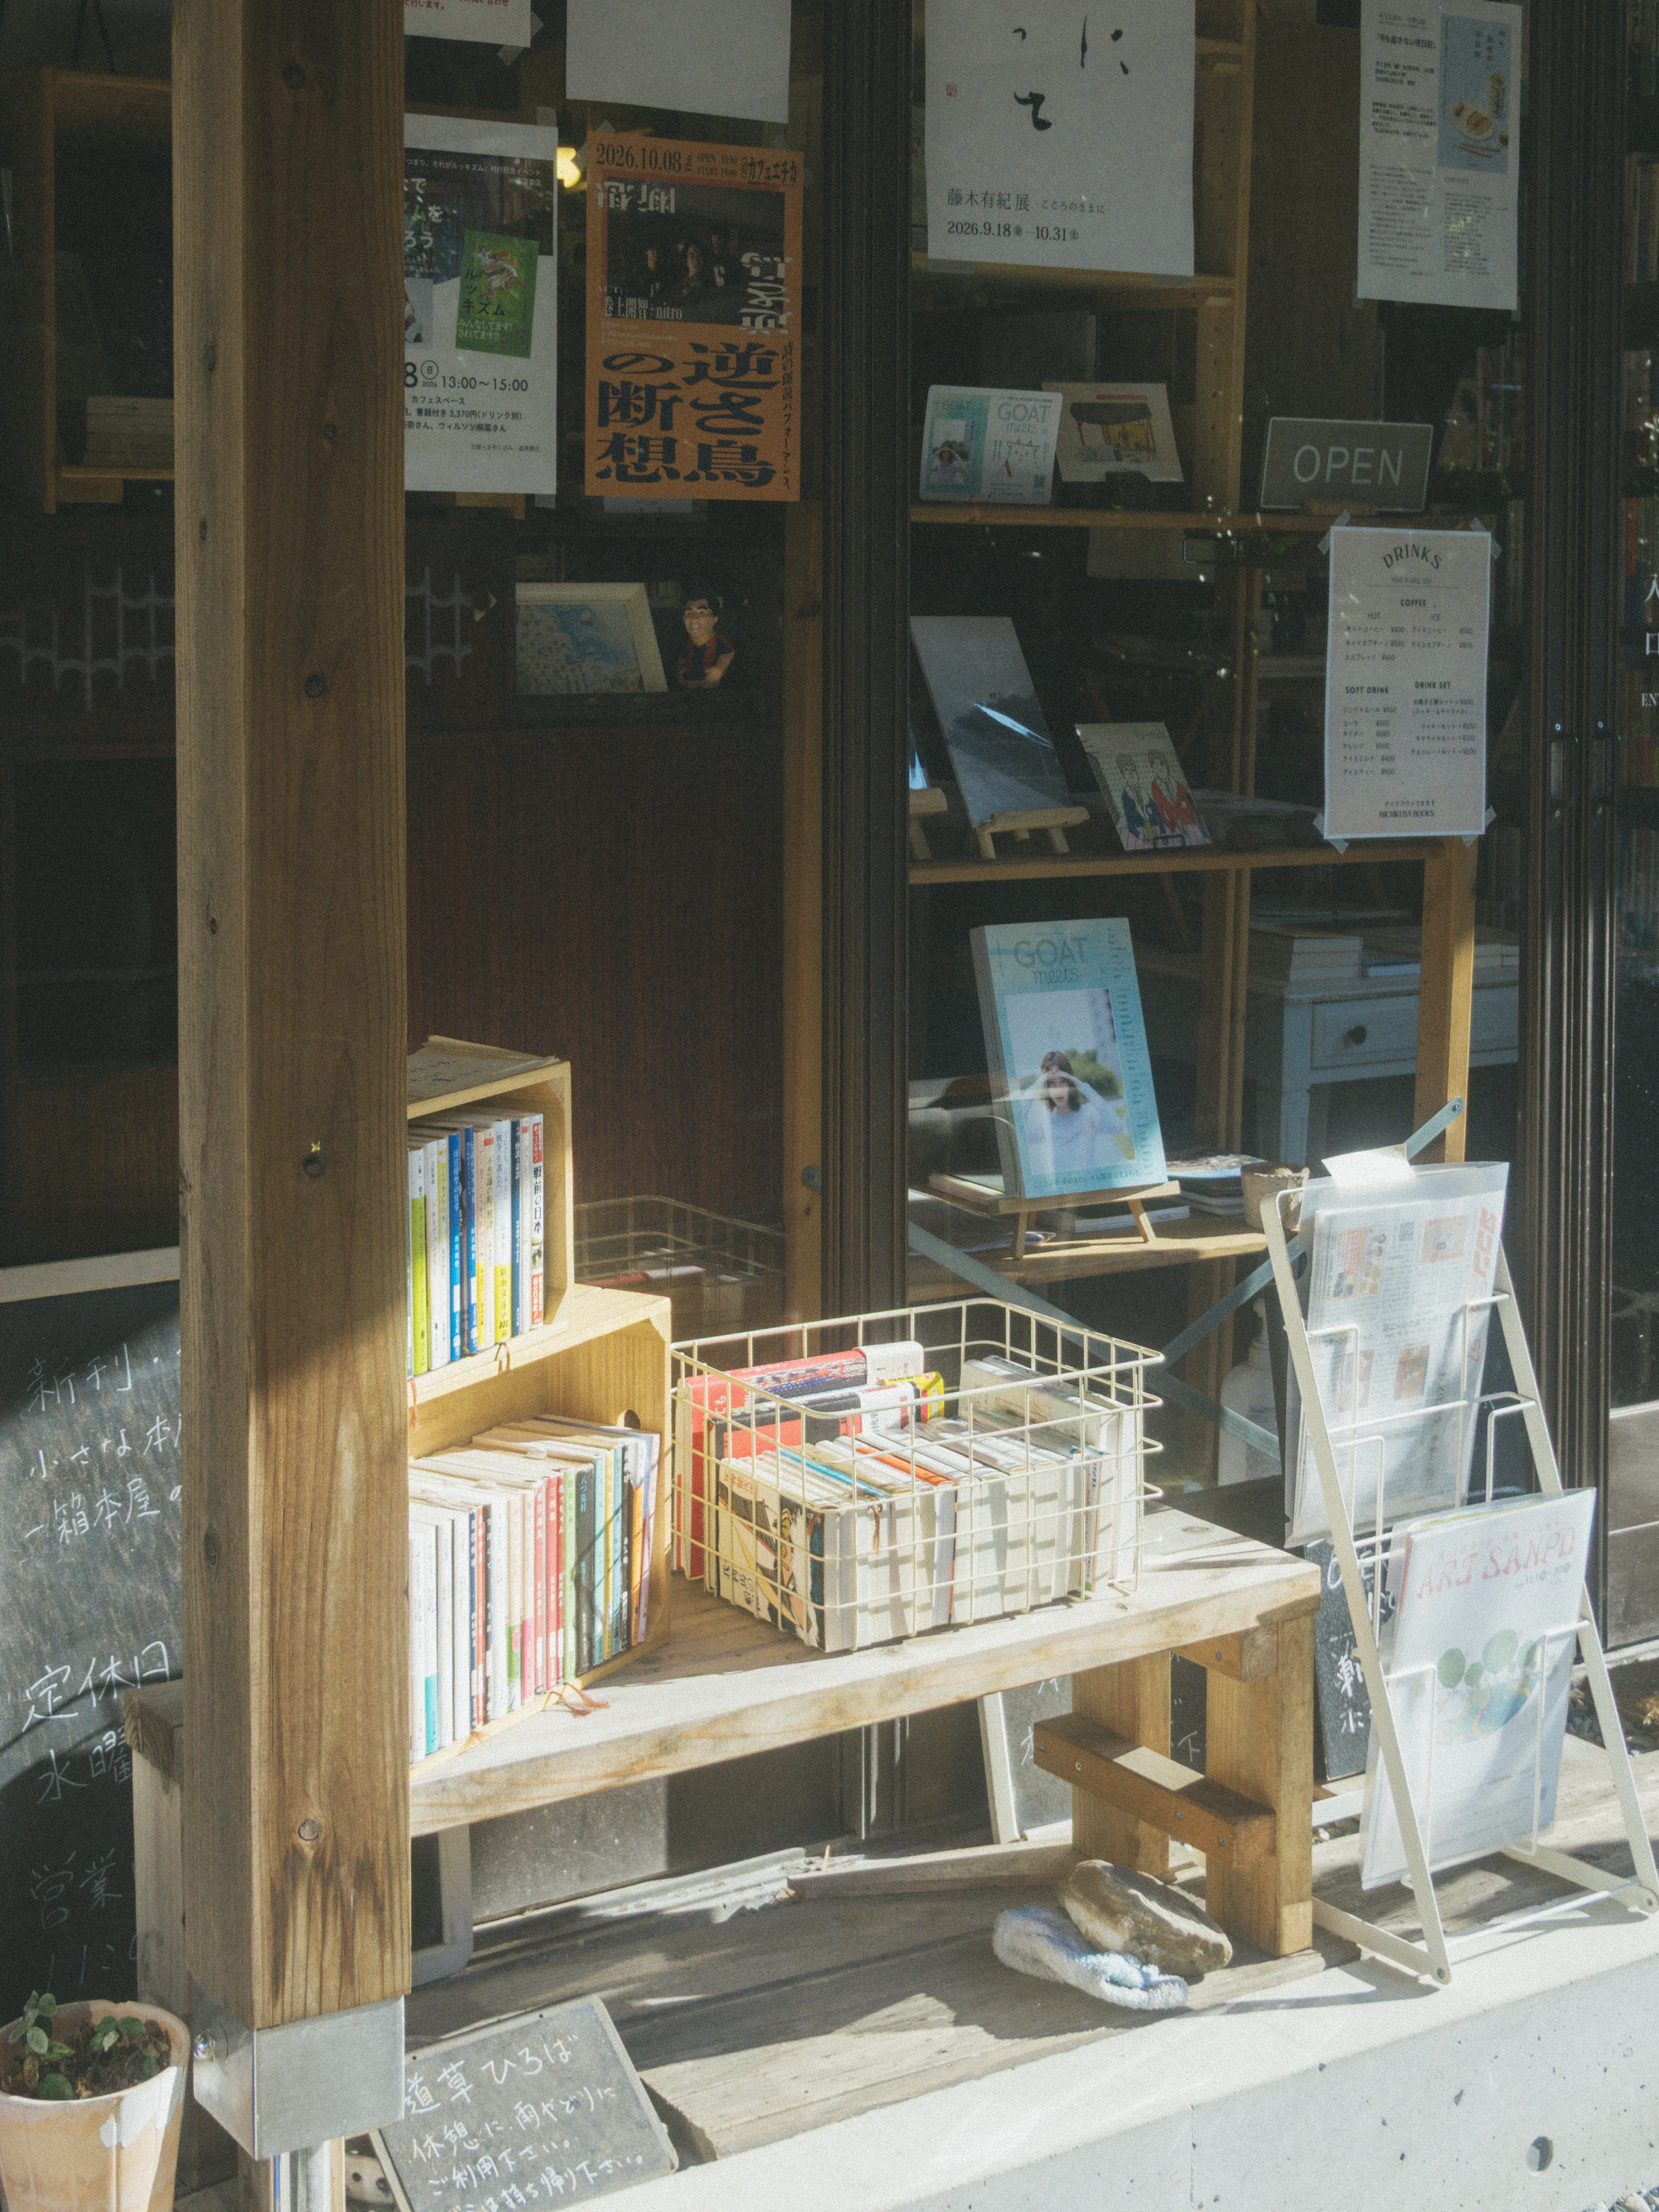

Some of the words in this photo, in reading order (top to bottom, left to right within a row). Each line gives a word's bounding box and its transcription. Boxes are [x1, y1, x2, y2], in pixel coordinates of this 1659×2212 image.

[596, 142, 682, 173] 2026.10.08
[946, 187, 1030, 212] 藤木有紀展
[411, 395, 466, 405] カフェスペース
[997, 401, 1052, 423] GOAT
[1293, 445, 1404, 485] OPEN
[1382, 544, 1442, 570] DRINKS
[1400, 599, 1427, 607] COFFEE
[1367, 612, 1381, 620] HOT
[1345, 686, 1364, 695] SOFT
[1366, 686, 1390, 695] DRINK
[1415, 681, 1436, 690] DRINK
[1439, 681, 1452, 690] SET
[1640, 692, 1659, 707] EN
[1013, 936, 1088, 968] GOAT
[1032, 967, 1079, 985] meets
[533, 1165, 542, 1235] 戦前の日本
[27, 1335, 181, 1413] 新刊・
[29, 1413, 182, 1478] 小さな本
[1416, 1551, 1479, 1600] ART
[1481, 1527, 1576, 1581] SANPO
[22, 1640, 170, 1733] 定休日
